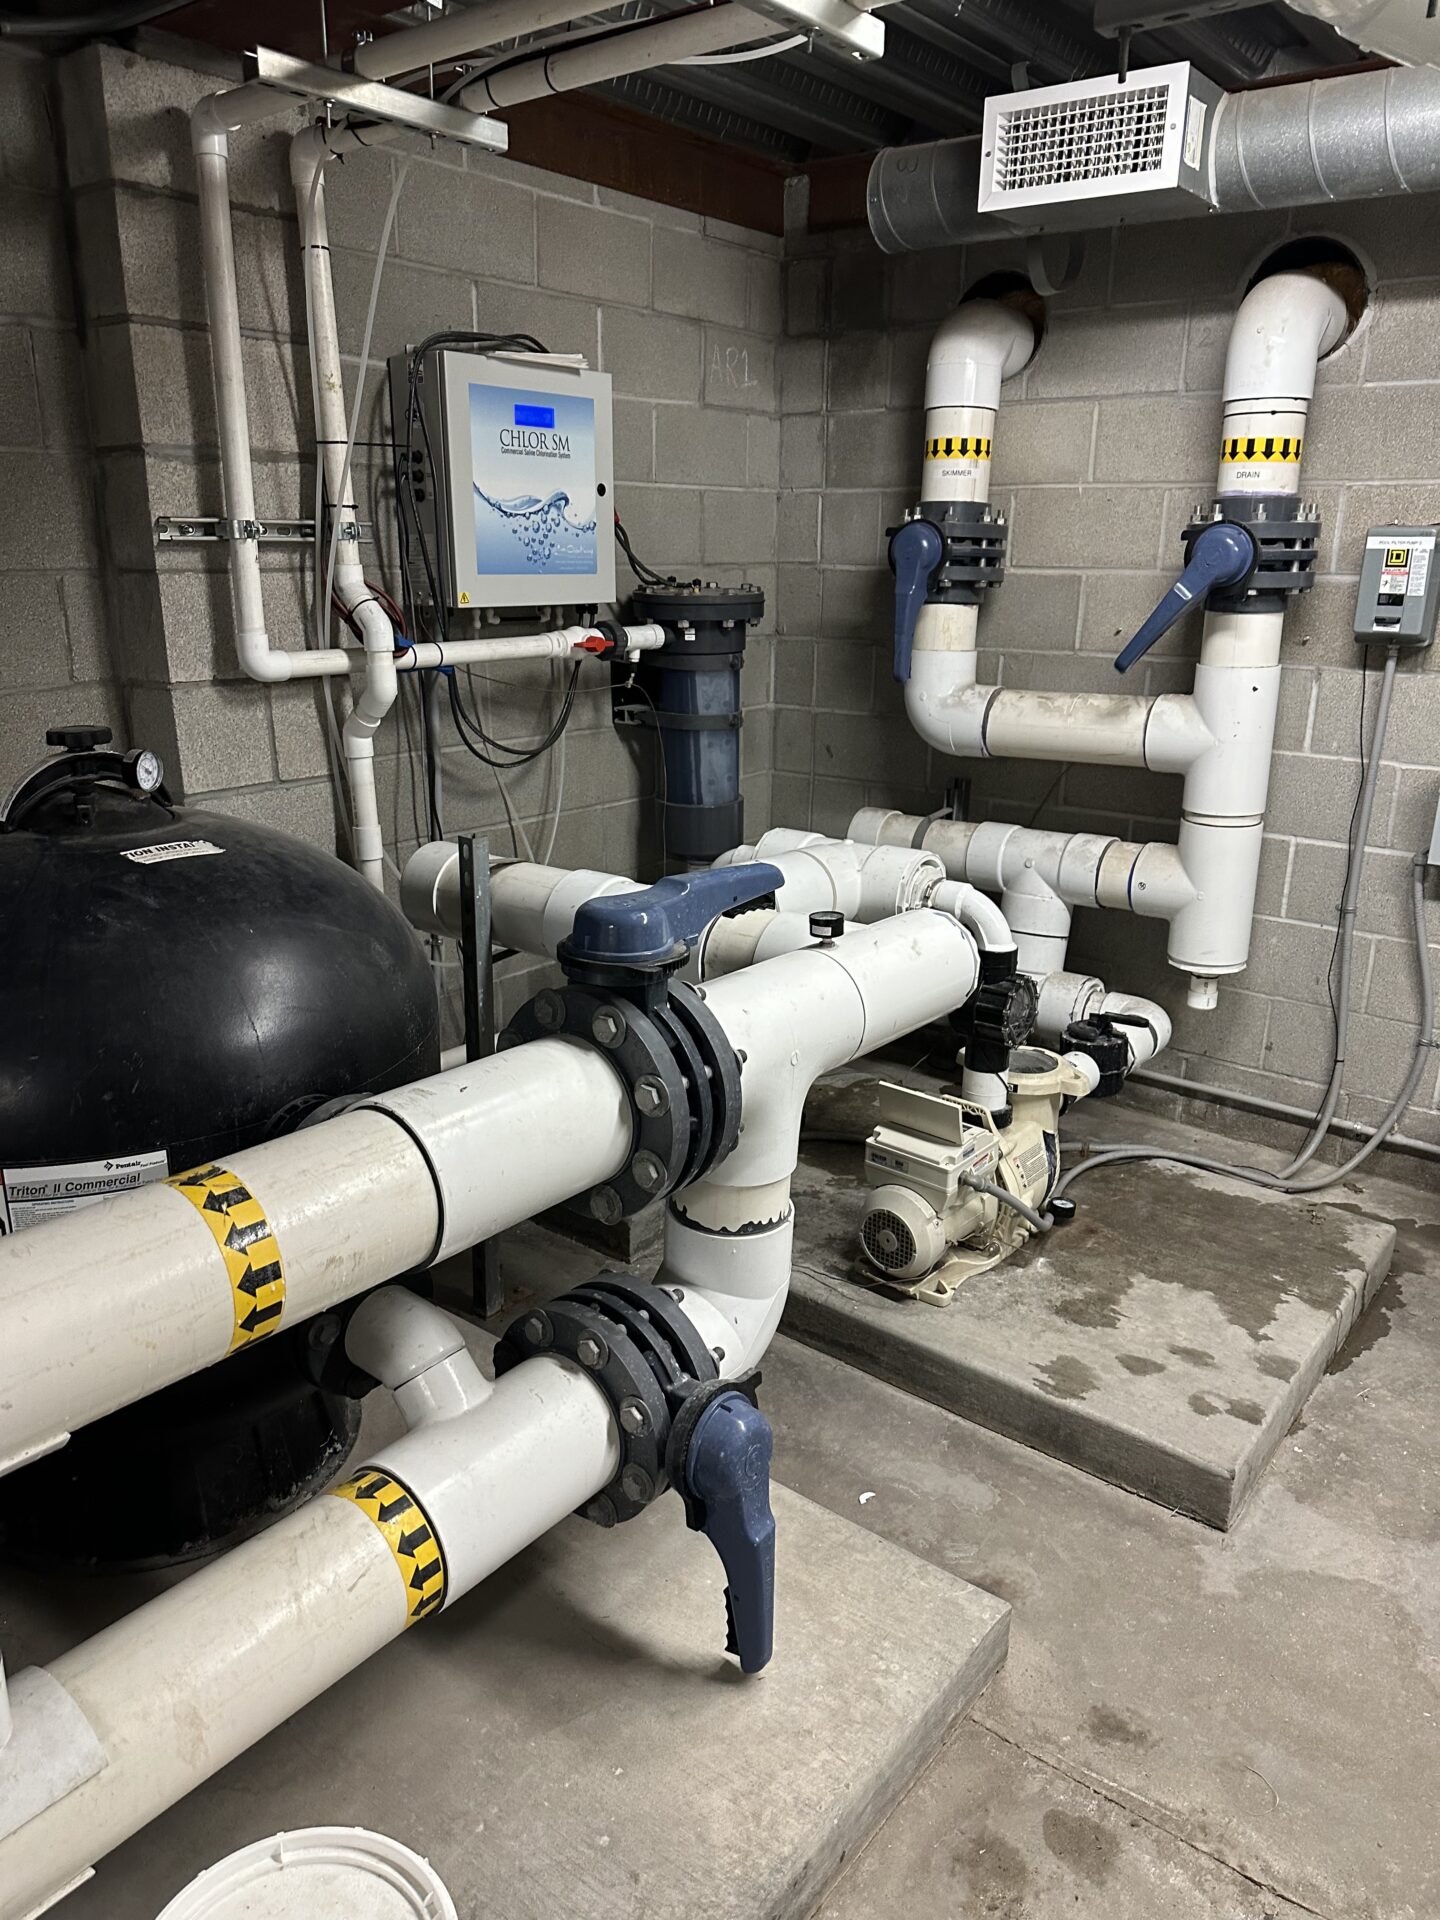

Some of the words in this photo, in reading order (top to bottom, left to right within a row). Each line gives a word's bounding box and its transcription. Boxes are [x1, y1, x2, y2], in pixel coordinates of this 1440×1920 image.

[500, 428, 549, 450] CHLOR
[552, 433, 571, 452] SM
[501, 446, 523, 455] Commercial
[524, 448, 535, 456] Saline
[536, 449, 557, 458] Chlorination
[558, 451, 571, 459] System
[941, 469, 972, 477] SKIMMER
[1236, 471, 1260, 479] DRAIN
[115, 1160, 141, 1170] Pentair
[53, 1183, 61, 1194] II
[65, 1172, 141, 1191] Commercial
